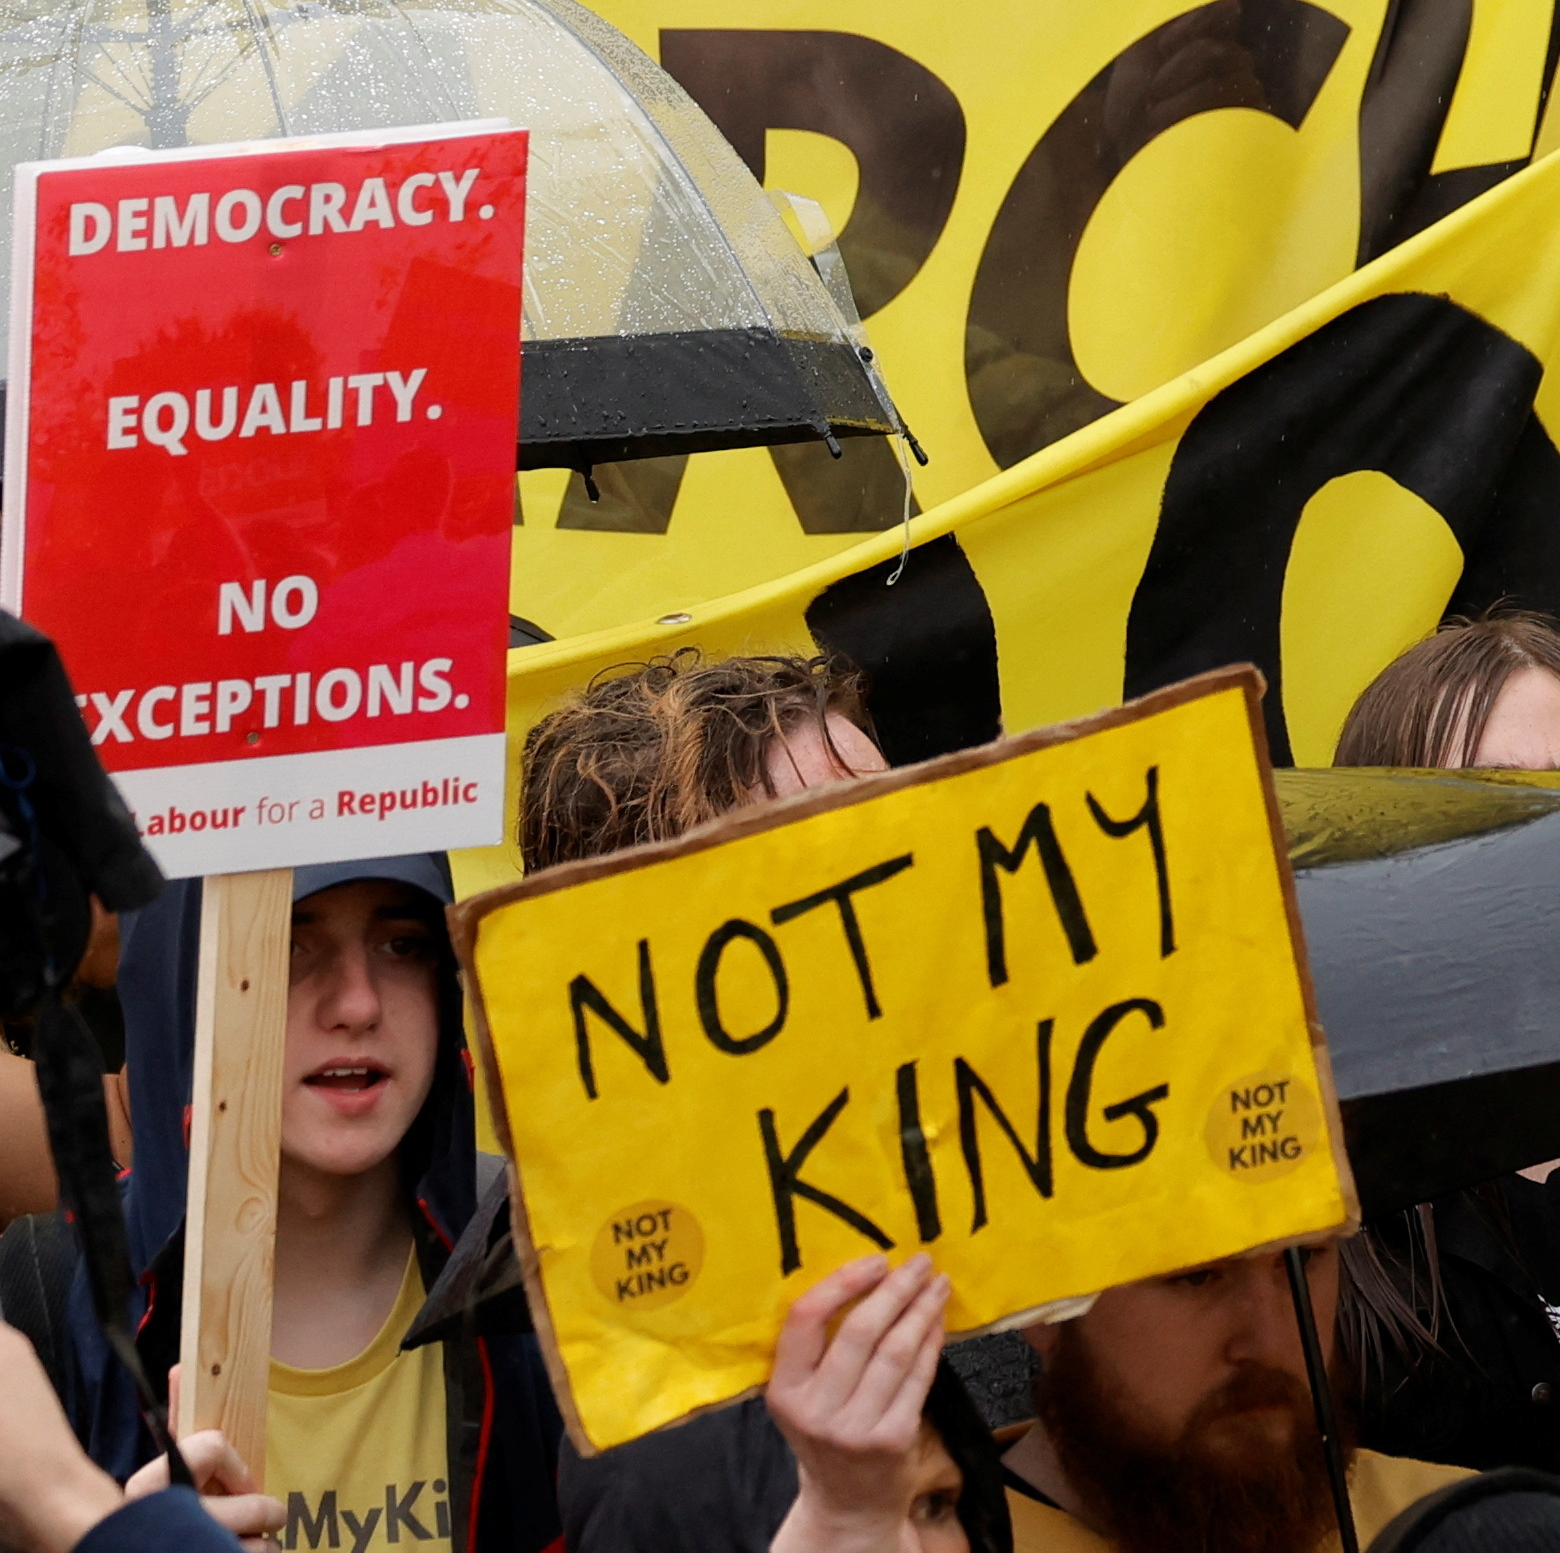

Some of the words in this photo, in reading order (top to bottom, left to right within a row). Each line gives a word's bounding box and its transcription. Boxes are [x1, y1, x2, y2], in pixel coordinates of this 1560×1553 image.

[67, 168, 495, 257] DEMOCRACY.
[107, 367, 442, 456] EQUALITY.
[217, 575, 320, 635] NO
[256, 796, 301, 826] for
[309, 799, 325, 820] a
[337, 778, 479, 820] Republic
[569, 851, 914, 1100] NOT
[975, 765, 1179, 989] MY
[1231, 1080, 1291, 1114] NOT
[757, 997, 1171, 1278] KING
[1241, 1110, 1284, 1140] MY
[1228, 1135, 1302, 1171] KING
[612, 1207, 674, 1245] NOT
[626, 1238, 669, 1271] MY
[615, 1261, 691, 1303] KING
